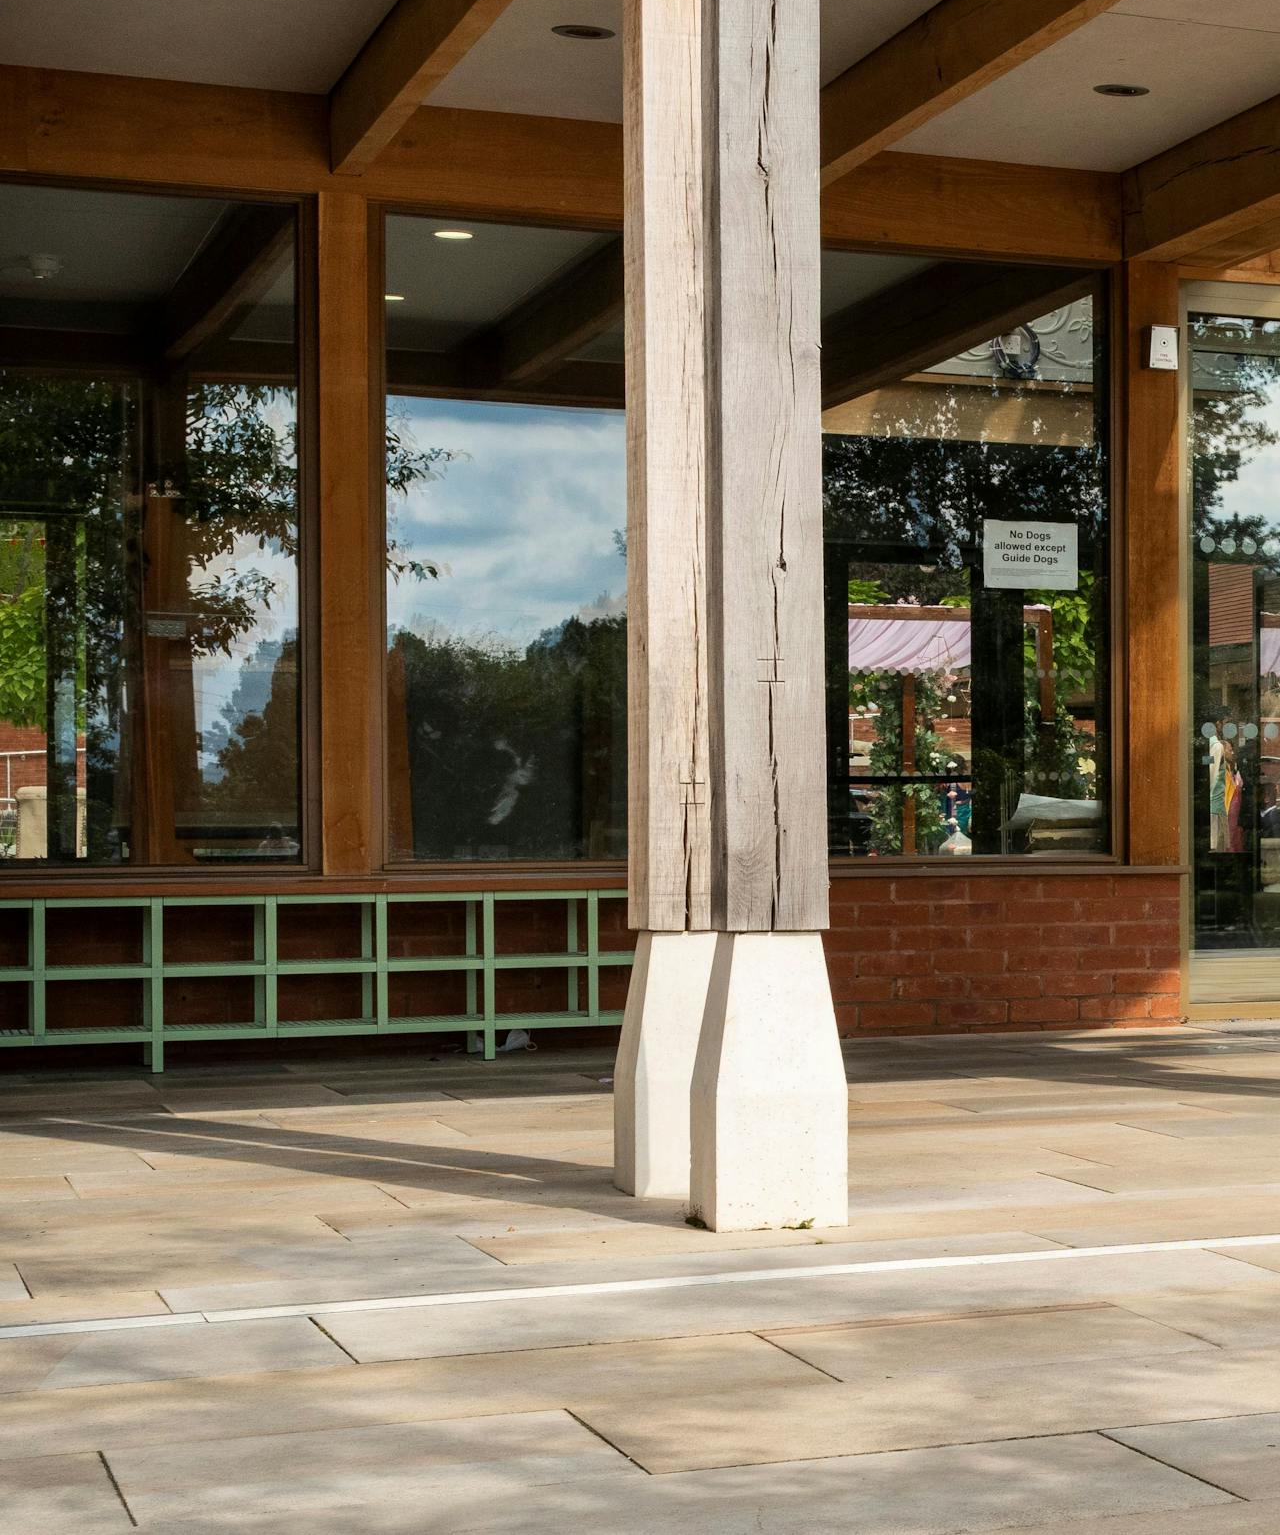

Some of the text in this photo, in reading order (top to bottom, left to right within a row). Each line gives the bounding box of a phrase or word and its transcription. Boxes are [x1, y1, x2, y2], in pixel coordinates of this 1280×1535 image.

[1010, 530, 1051, 541] No Dogs
[994, 542, 1066, 554] allowed except
[1002, 554, 1059, 565] Guide Dogs
